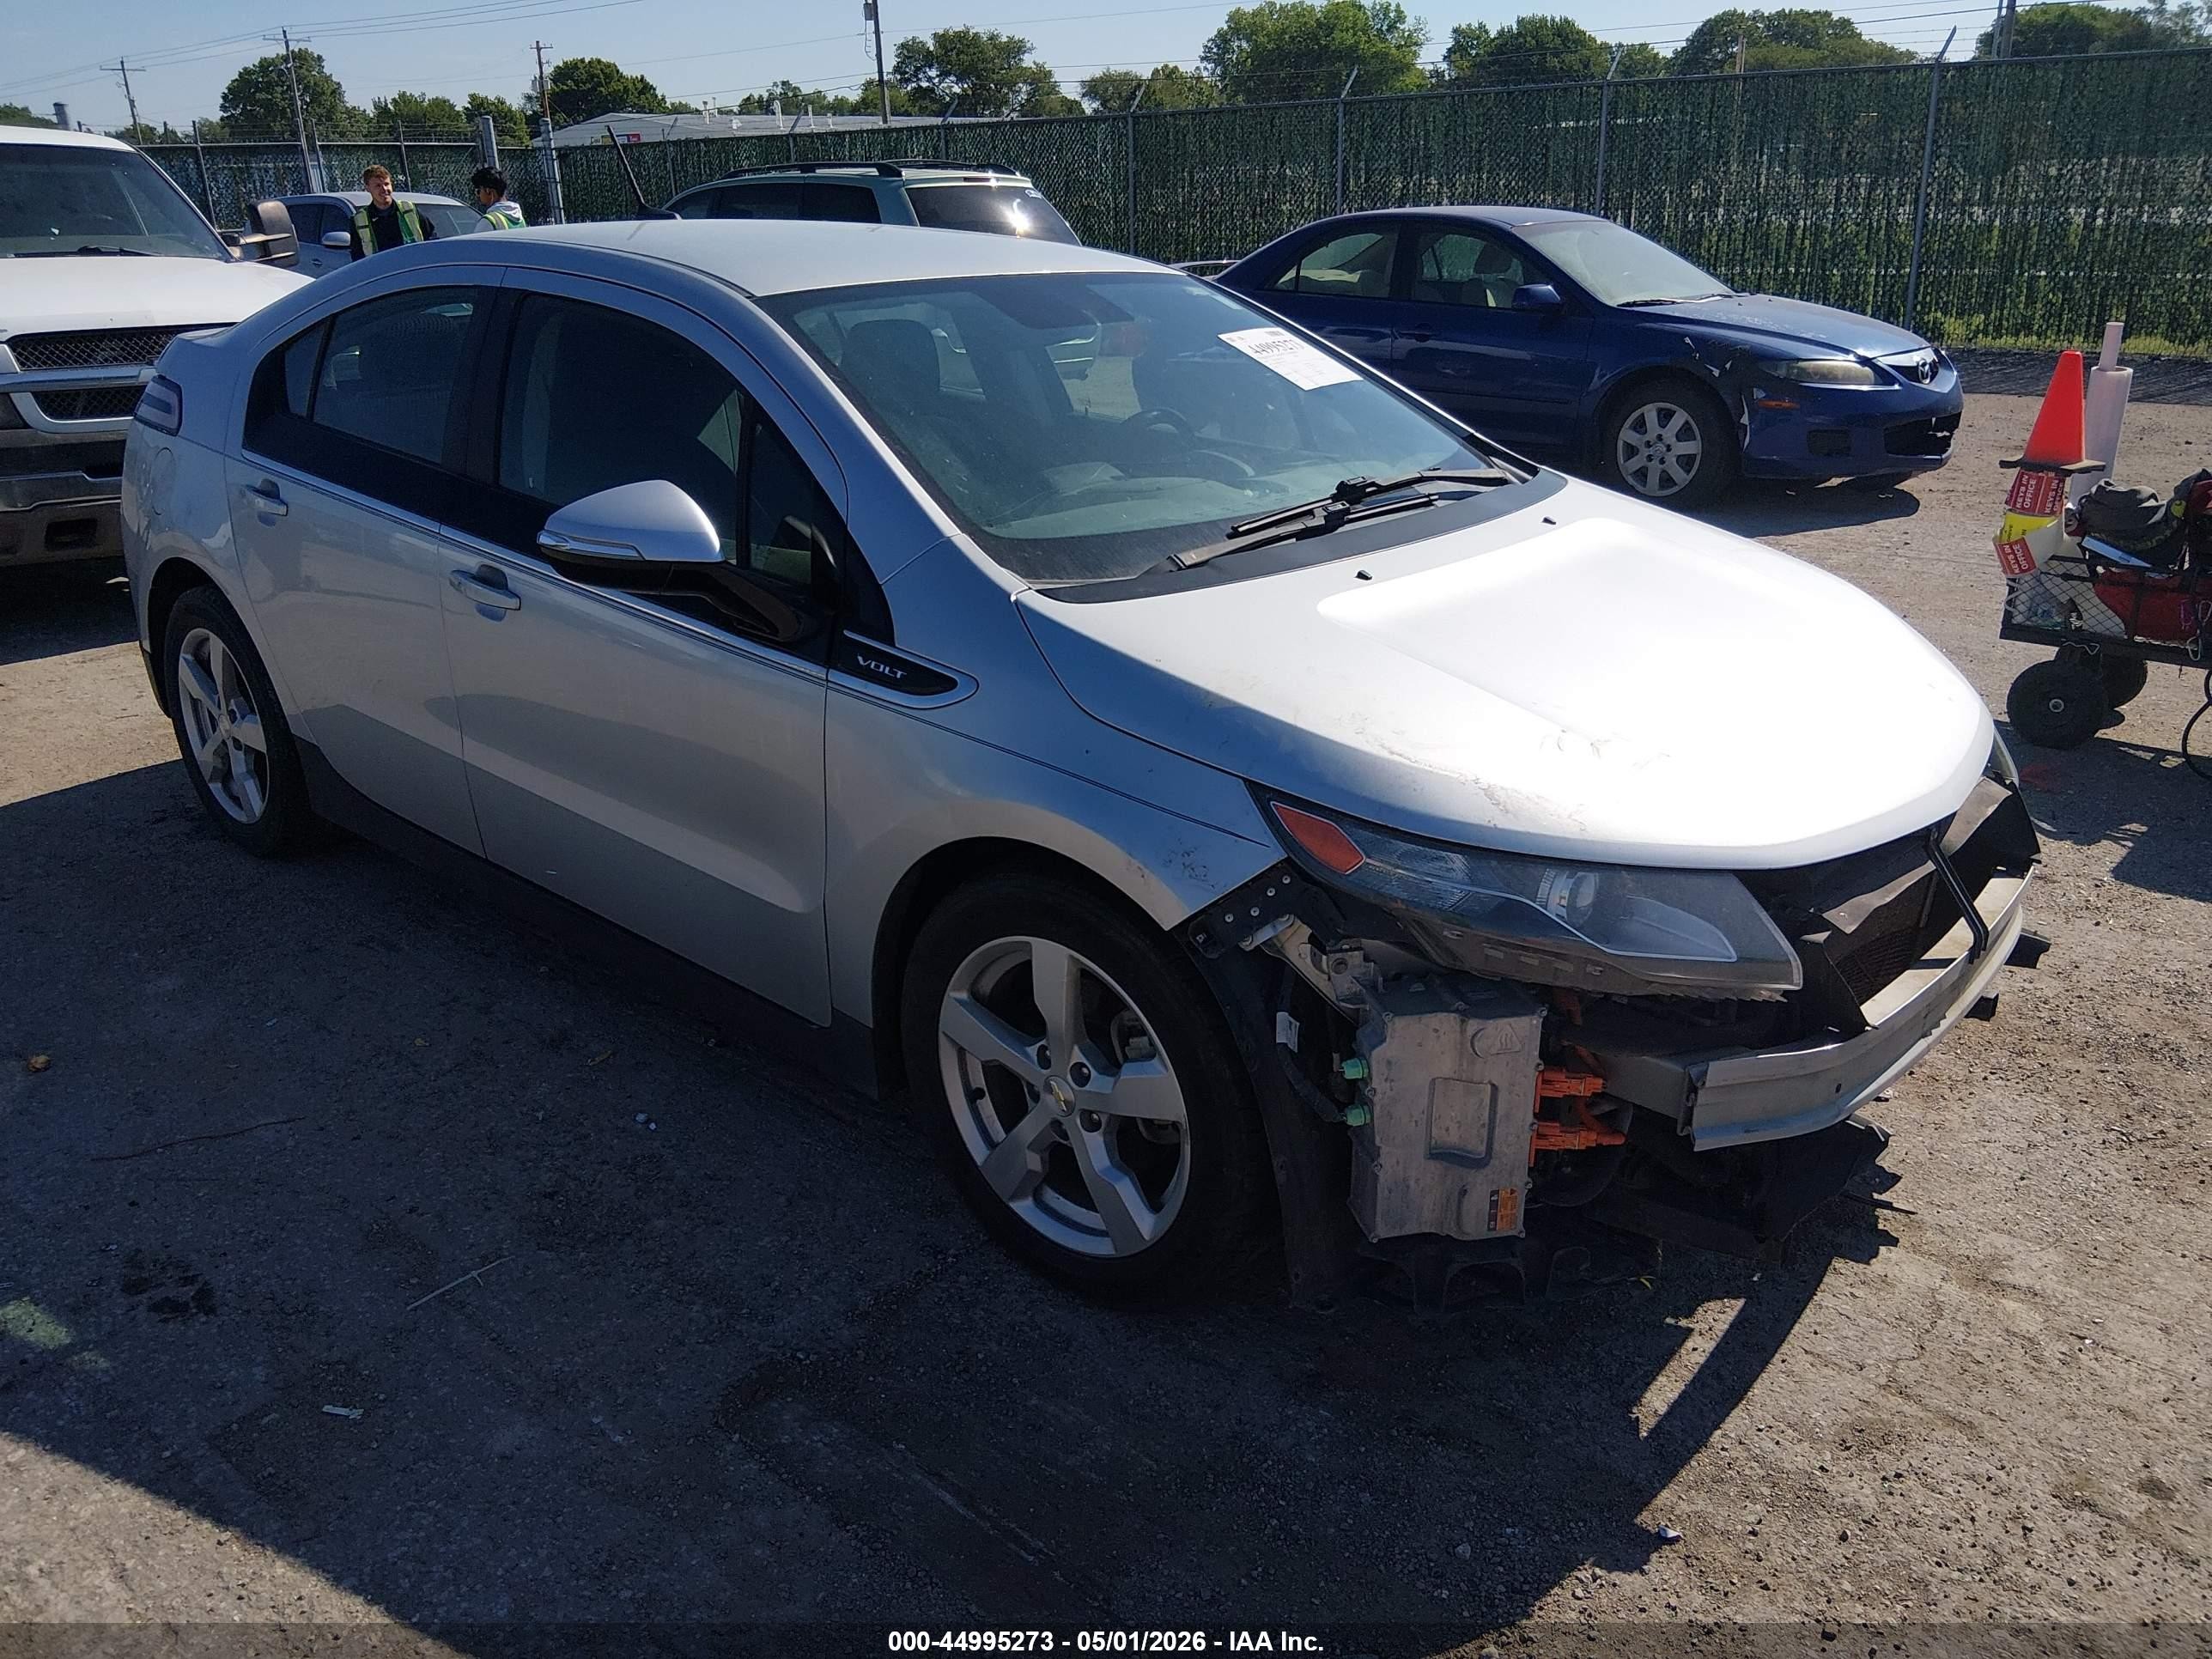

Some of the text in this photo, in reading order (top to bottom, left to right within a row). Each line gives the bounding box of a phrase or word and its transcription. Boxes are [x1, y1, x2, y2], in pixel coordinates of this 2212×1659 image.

[2015, 474, 2029, 508] KEYS IN
[2023, 478, 2037, 508] OFFICE
[2045, 479, 2058, 514] KEYS IN
[2002, 544, 2021, 574] KEYS IN
[2012, 544, 2028, 570] OFFICE
[857, 655, 908, 678] VOLT
